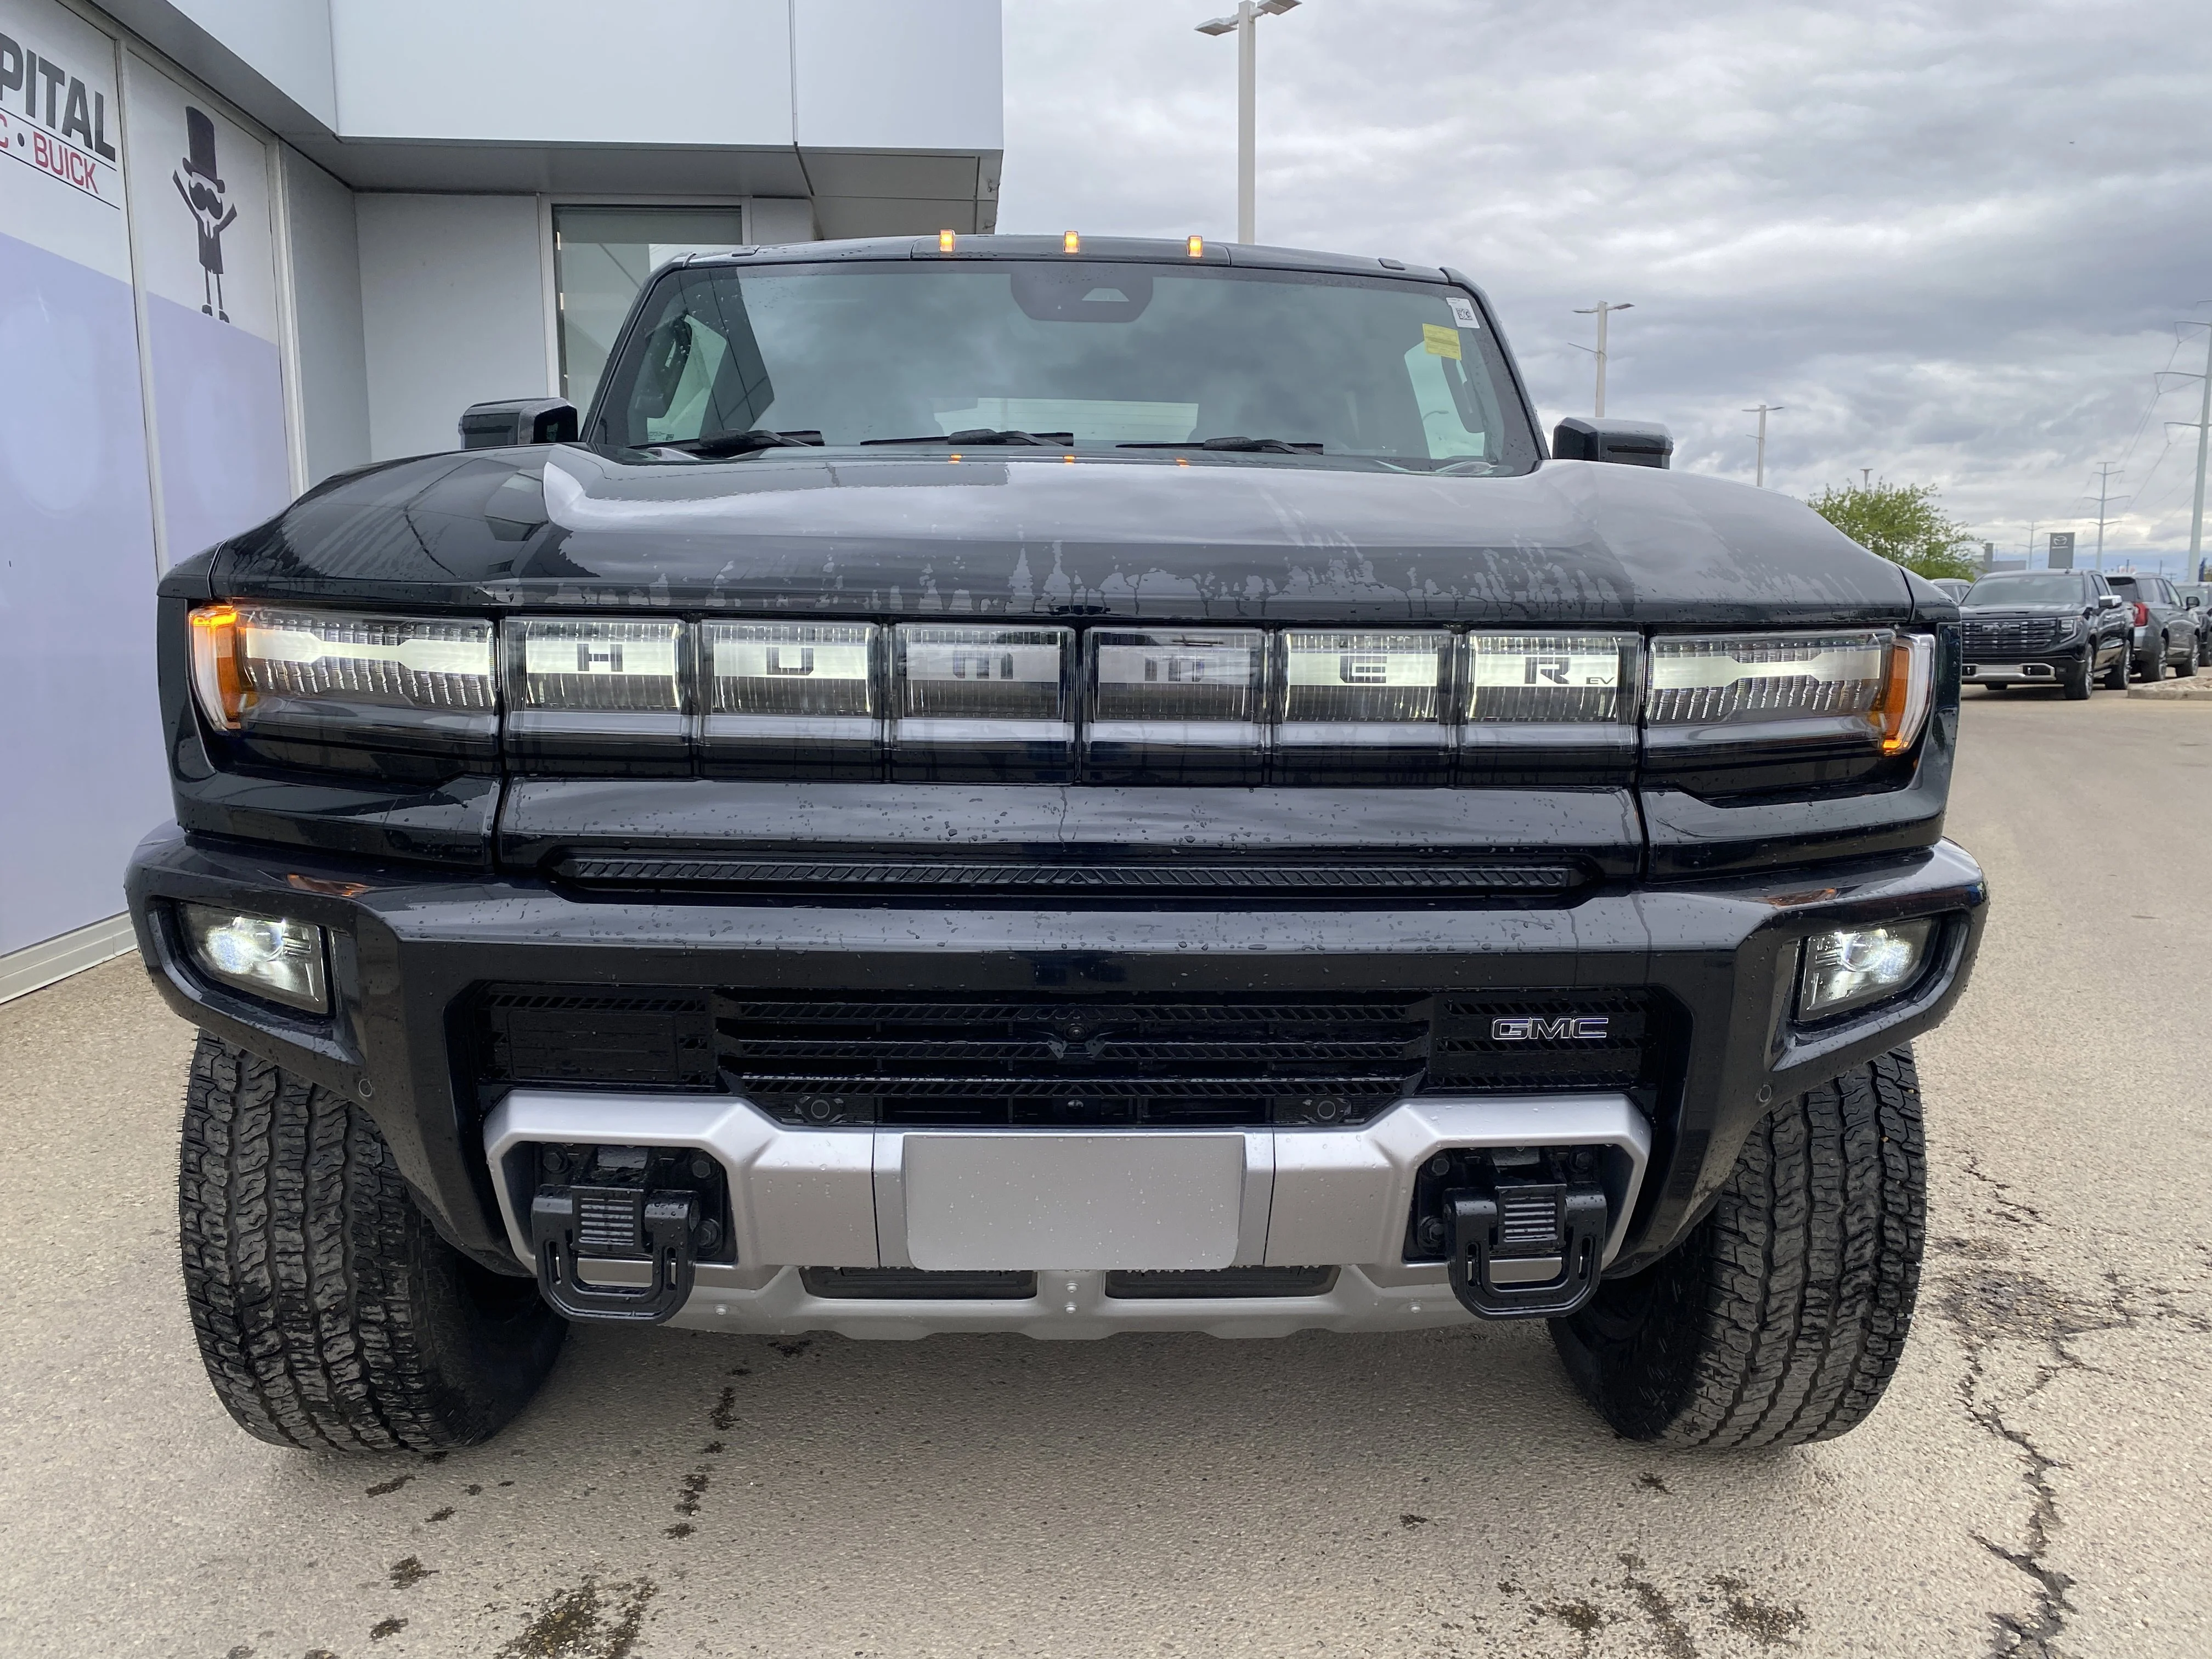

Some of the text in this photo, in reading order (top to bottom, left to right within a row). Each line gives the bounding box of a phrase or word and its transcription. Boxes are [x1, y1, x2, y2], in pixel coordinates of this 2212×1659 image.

[0, 32, 116, 163] PITAL
[33, 131, 99, 194] BUICK
[1585, 676, 1615, 685] EV
[1491, 1017, 1609, 1040] GMC
